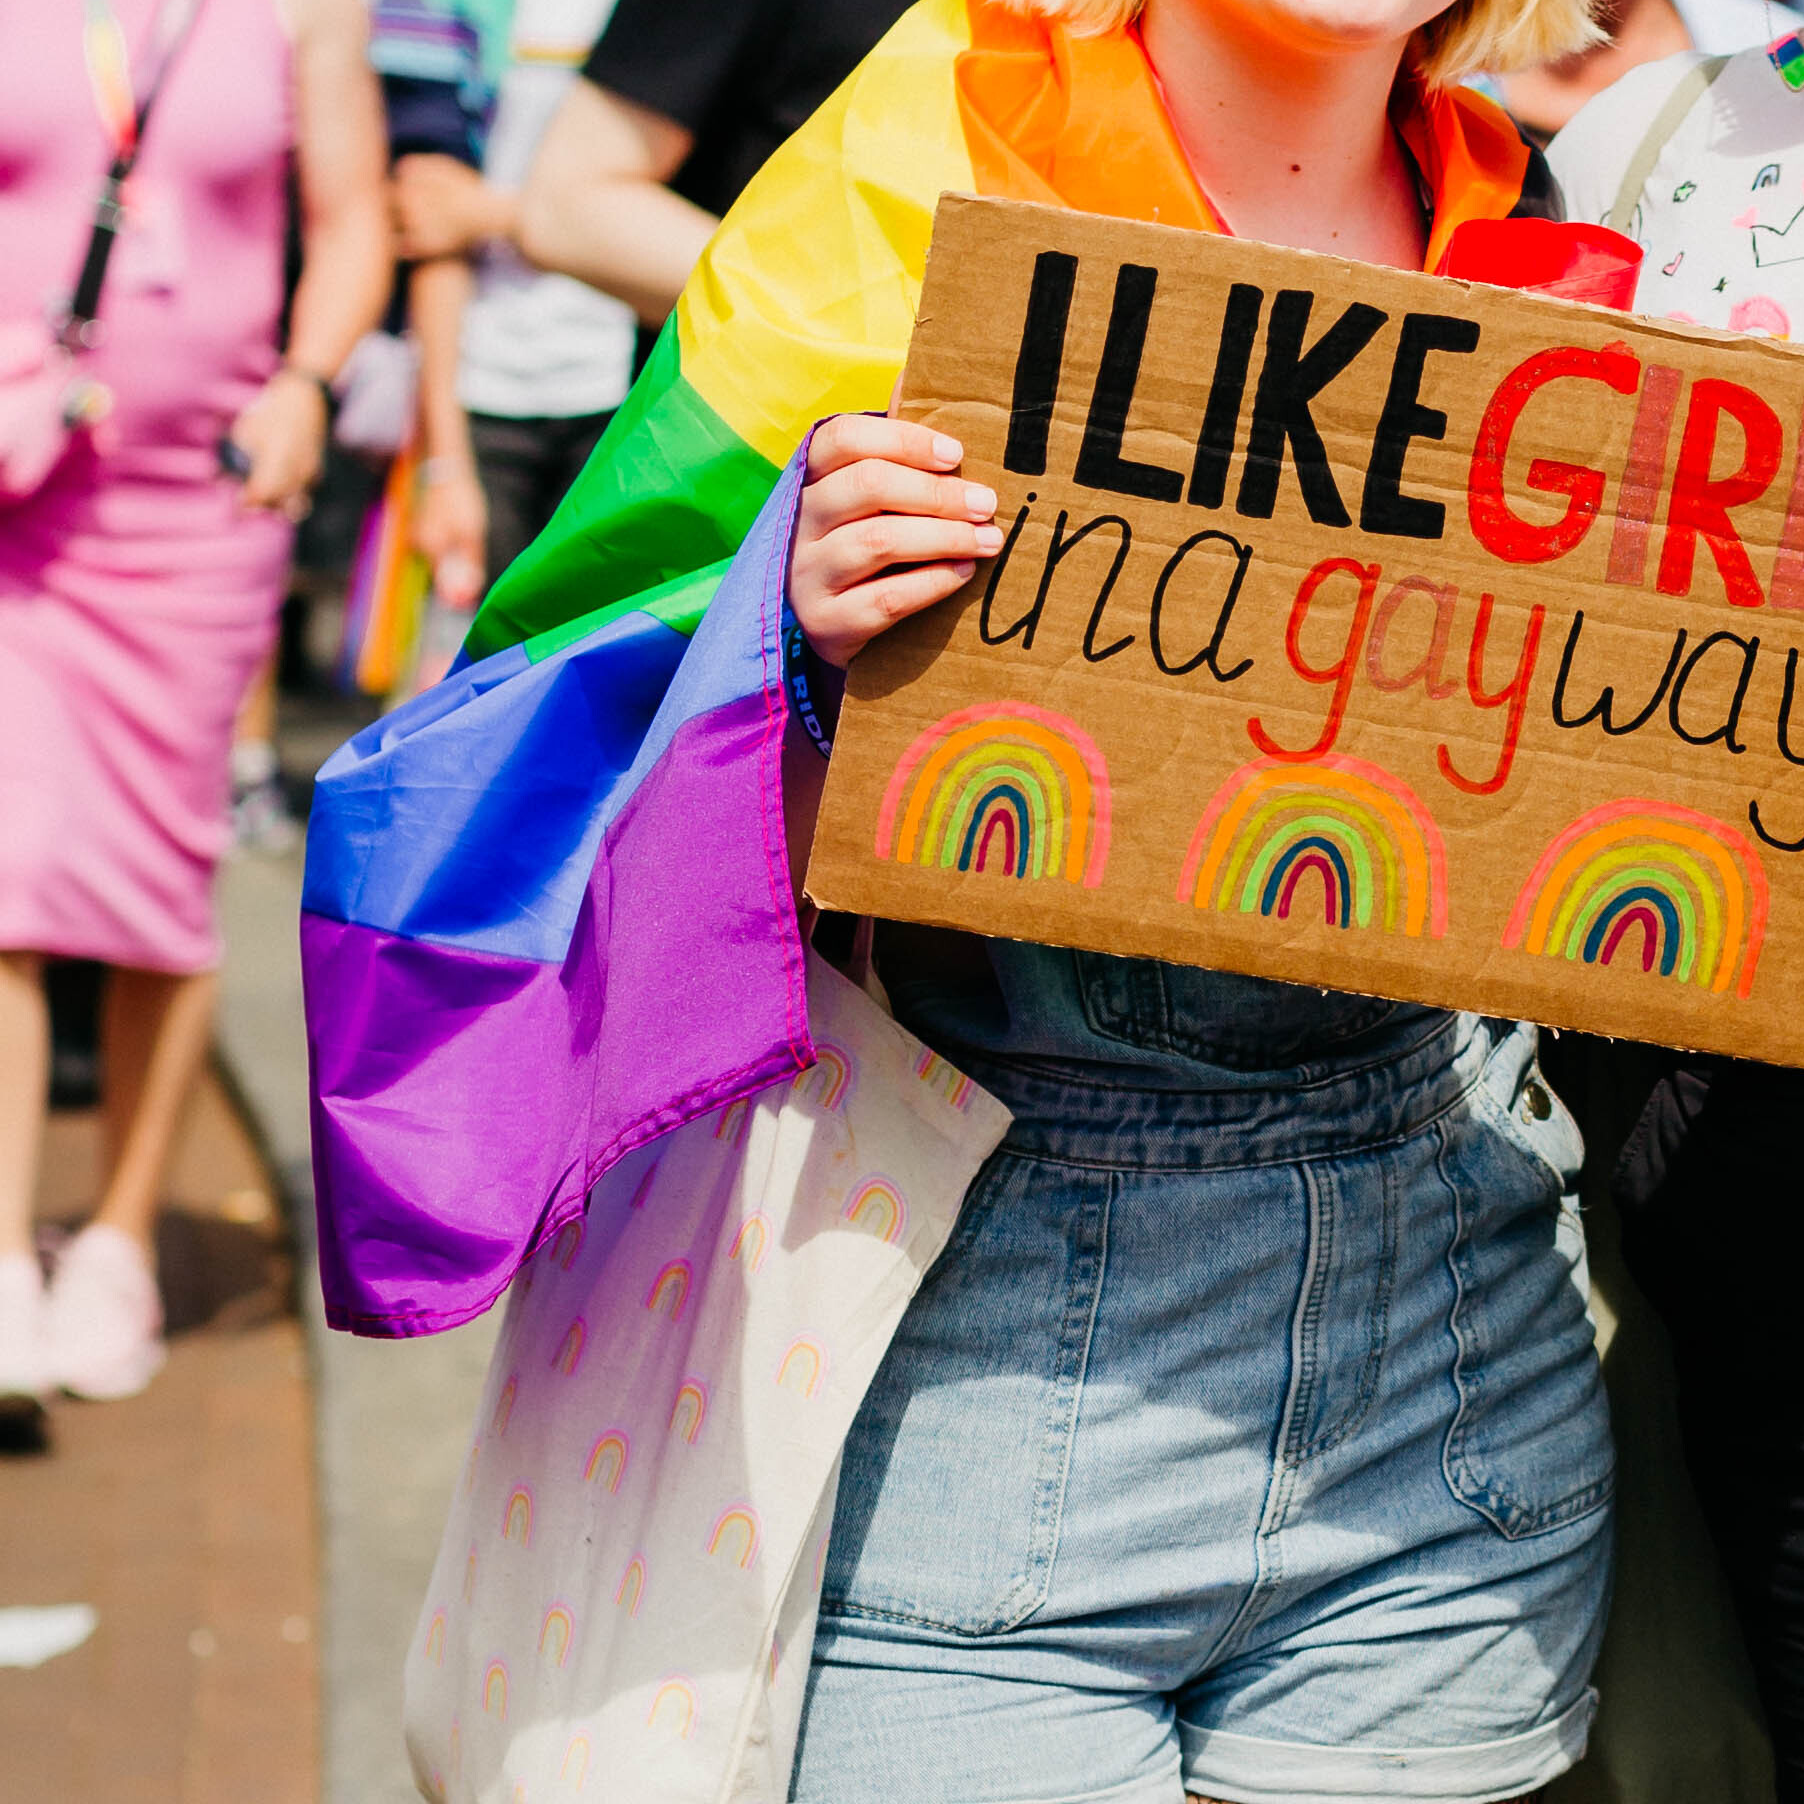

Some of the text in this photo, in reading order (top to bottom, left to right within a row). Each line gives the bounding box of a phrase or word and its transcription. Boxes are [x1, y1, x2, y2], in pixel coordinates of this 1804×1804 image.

[1002, 249, 1079, 478] I
[1073, 262, 1483, 542] LIKE
[1246, 555, 1547, 796] gay
